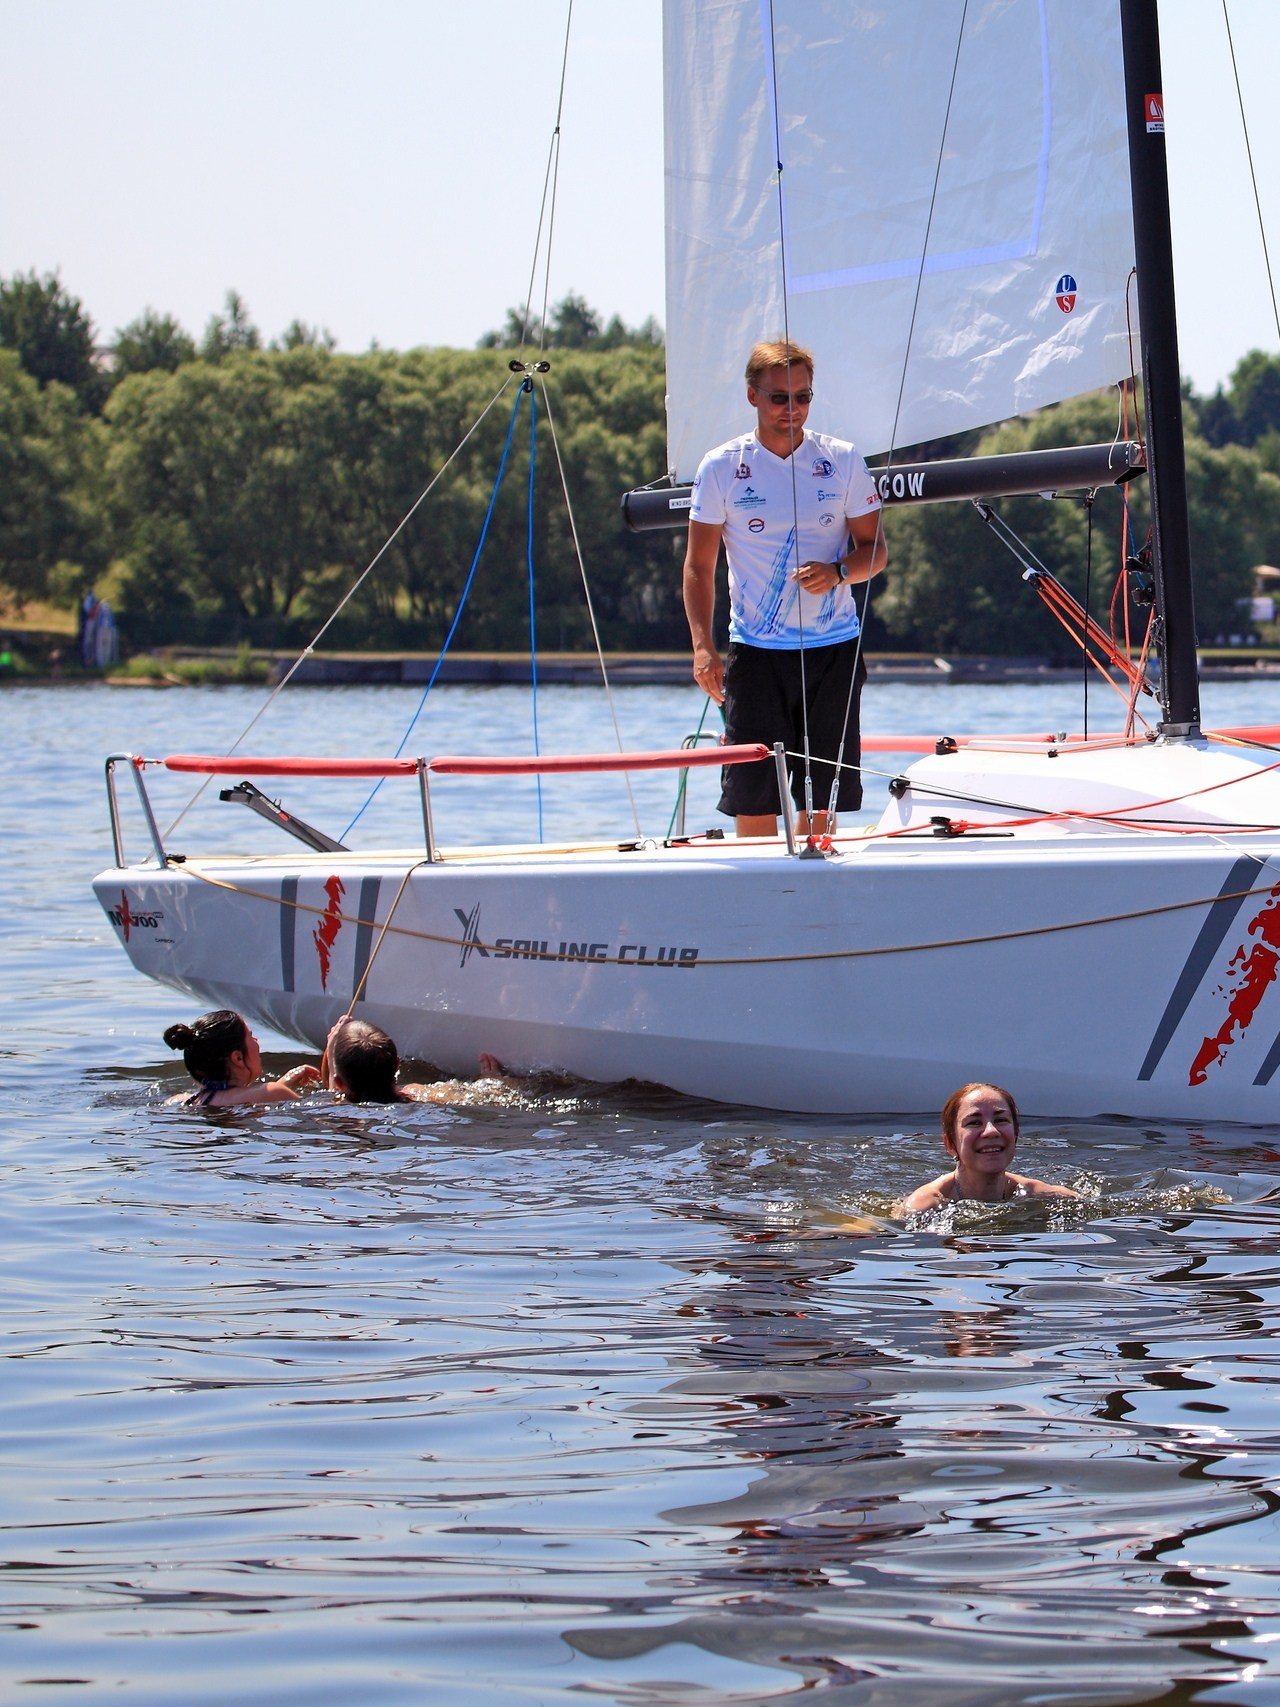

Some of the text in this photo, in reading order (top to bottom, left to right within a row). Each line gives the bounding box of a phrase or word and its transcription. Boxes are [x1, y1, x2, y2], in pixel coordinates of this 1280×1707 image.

[870, 472, 925, 499] COW
[494, 938, 608, 963] SAILING
[617, 945, 699, 968] CLUB
